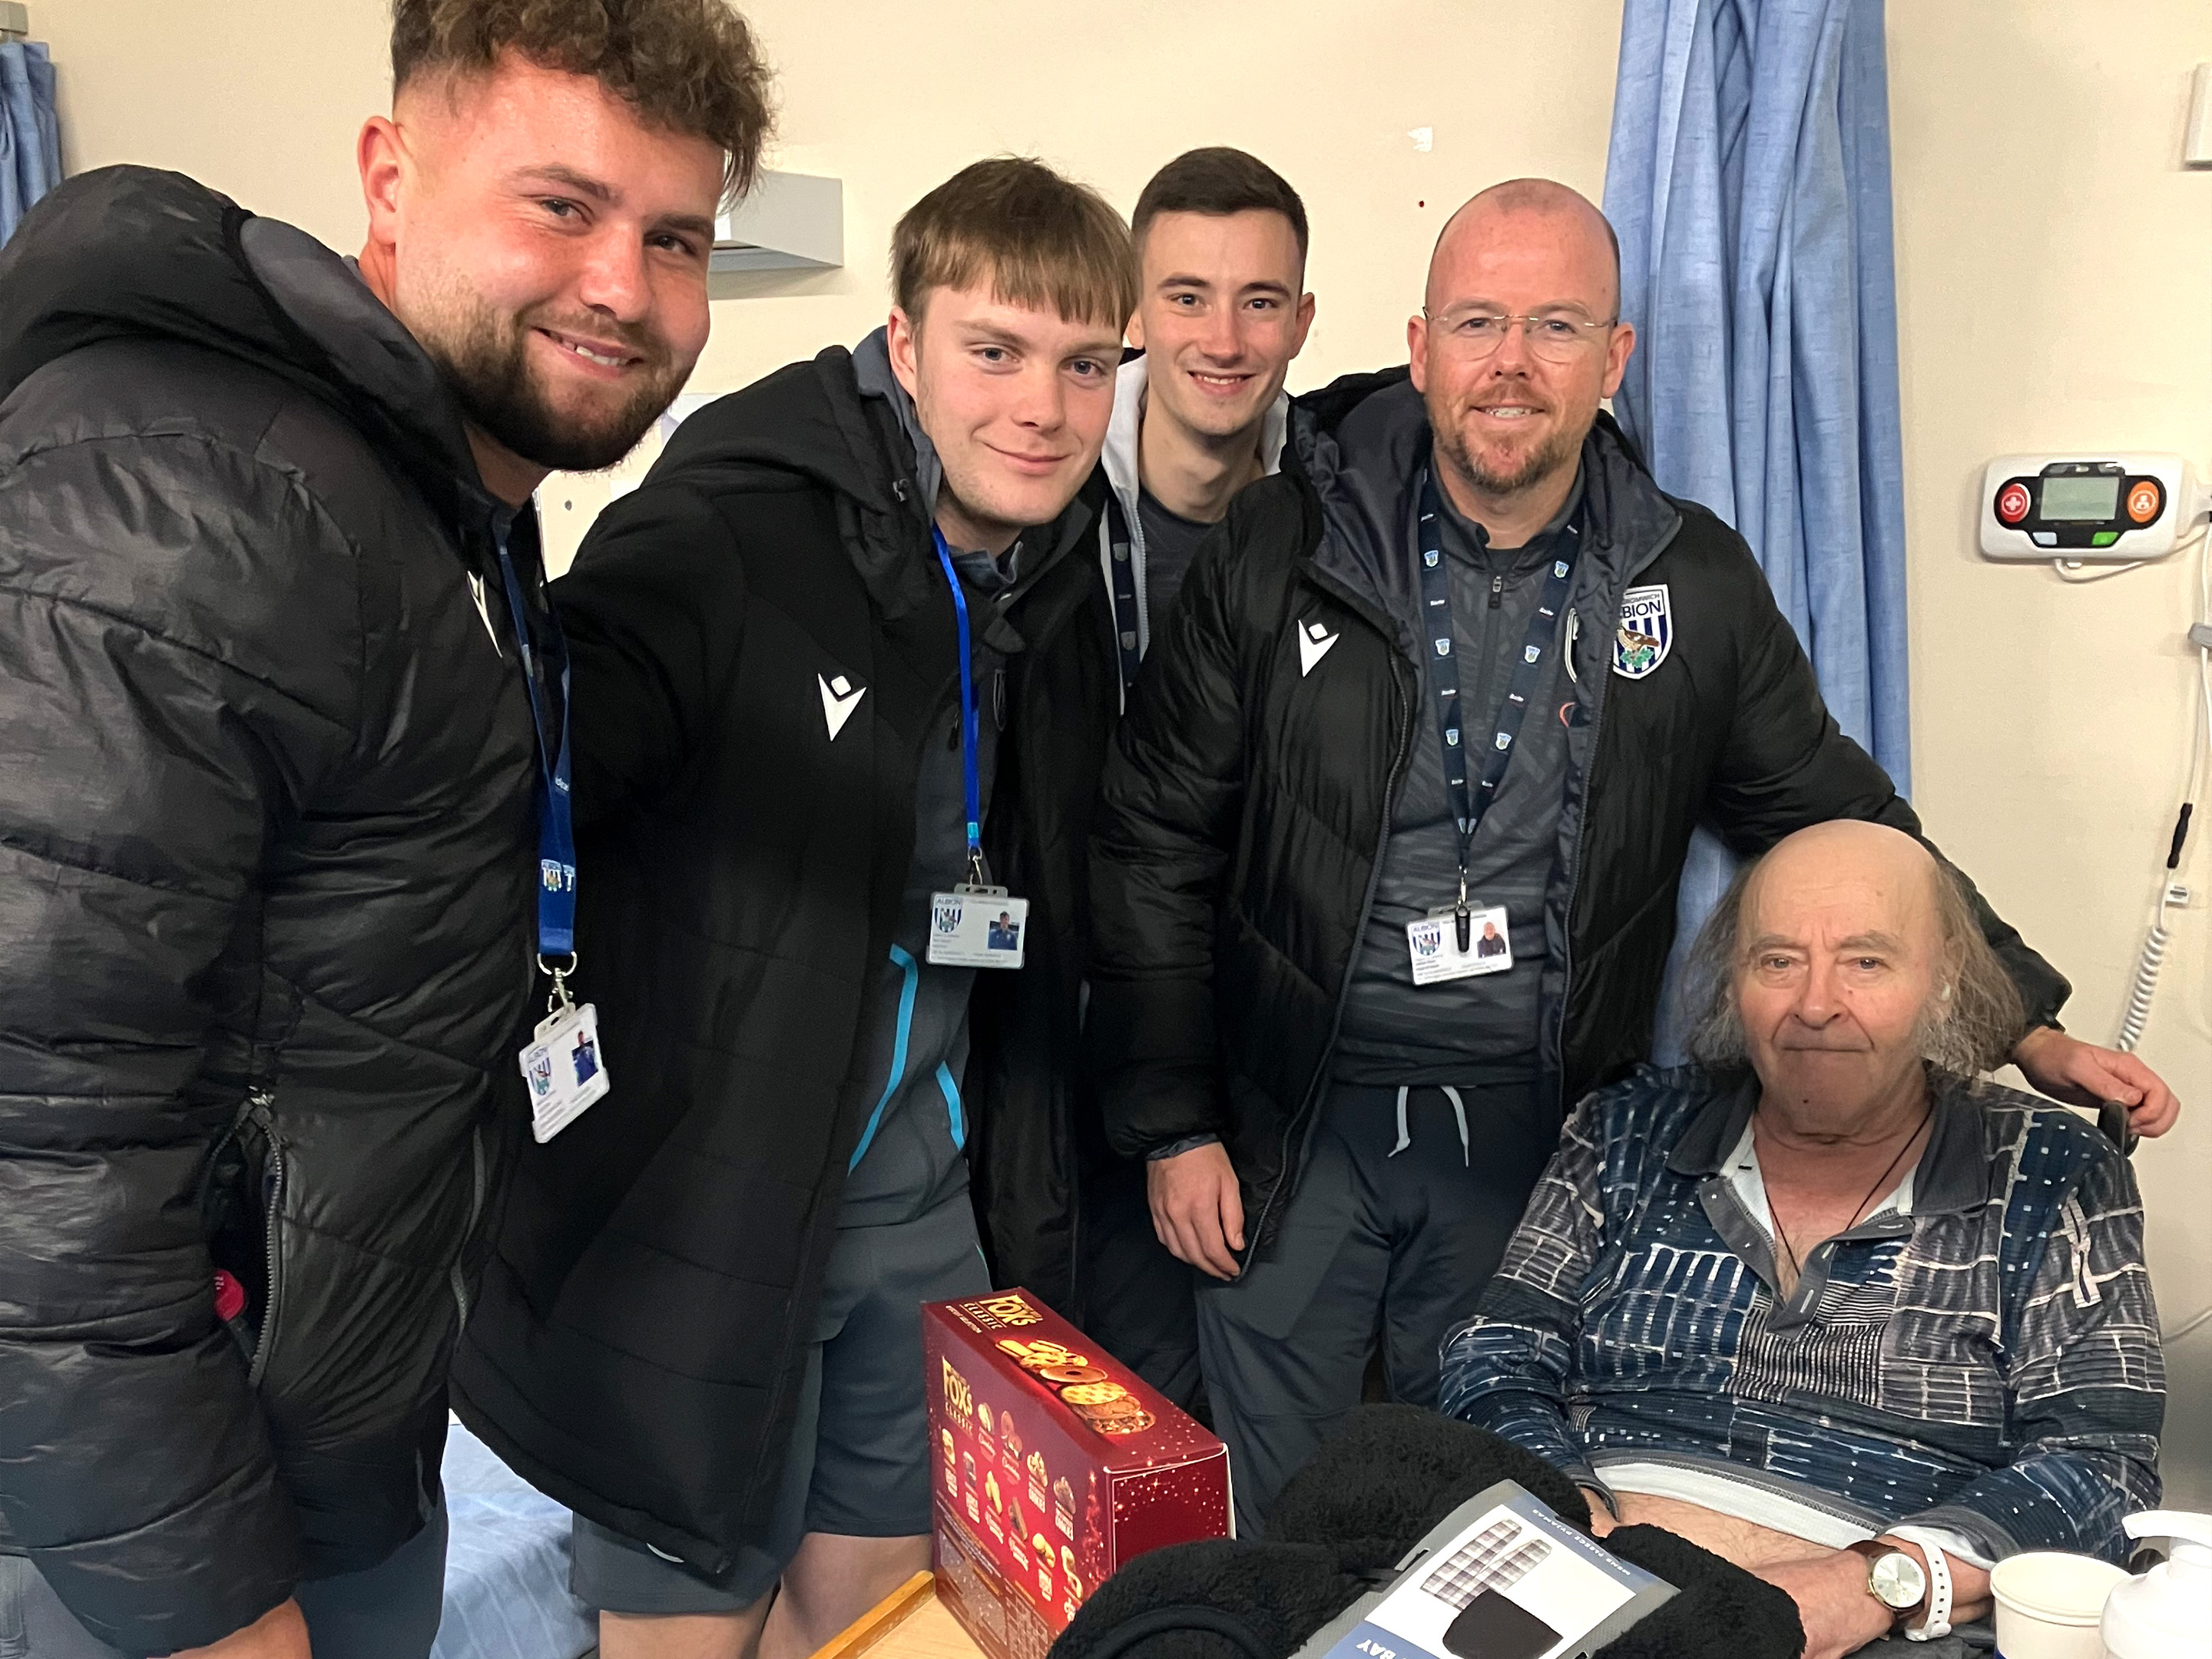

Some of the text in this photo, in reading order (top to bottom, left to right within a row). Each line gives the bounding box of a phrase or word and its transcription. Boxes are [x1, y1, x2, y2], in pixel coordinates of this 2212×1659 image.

[1623, 600, 1661, 618] BION
[964, 1303, 1003, 1330] CLASSIC
[1356, 1638, 1397, 1659] BAY
